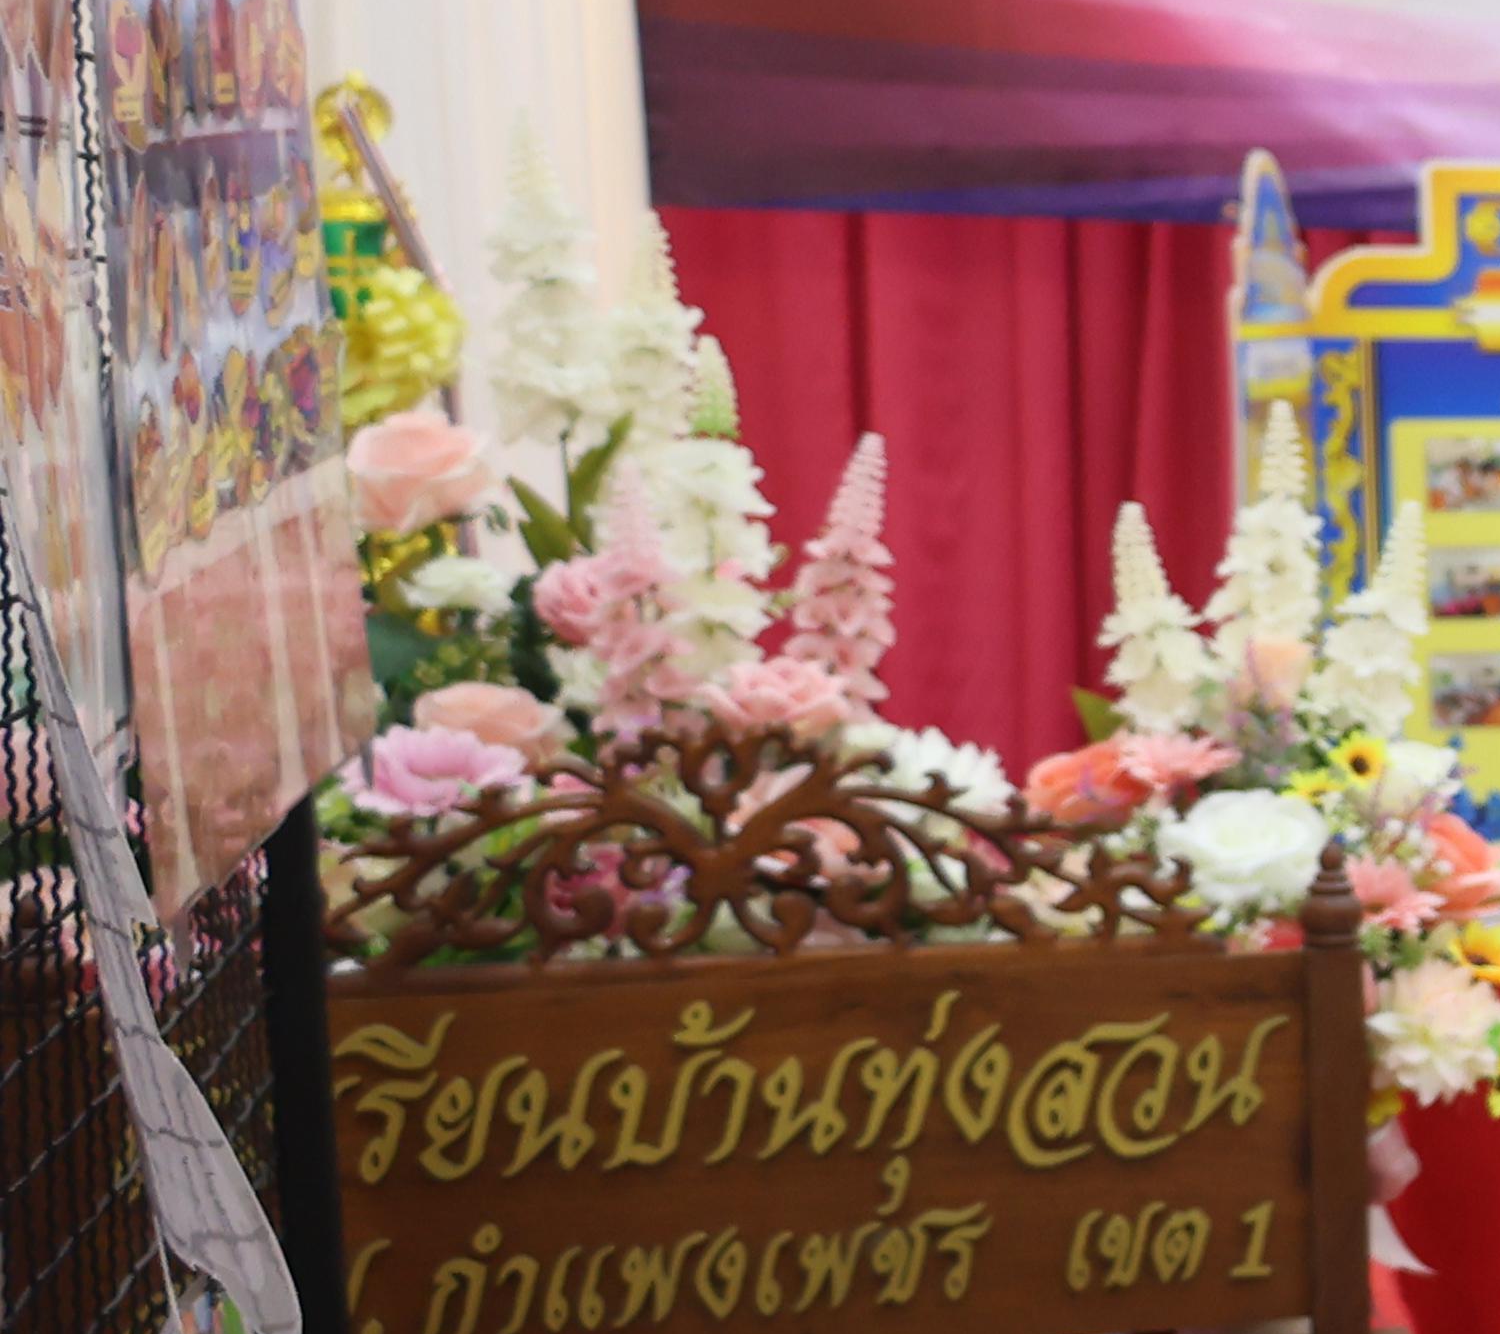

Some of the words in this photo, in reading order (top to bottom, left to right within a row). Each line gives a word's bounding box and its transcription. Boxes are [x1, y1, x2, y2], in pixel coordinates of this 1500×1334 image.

[334, 990, 1291, 1215] รียนบ้านทุ่งสวน
[1066, 1199, 1211, 1290] เขต
[1229, 1201, 1276, 1280] 1
